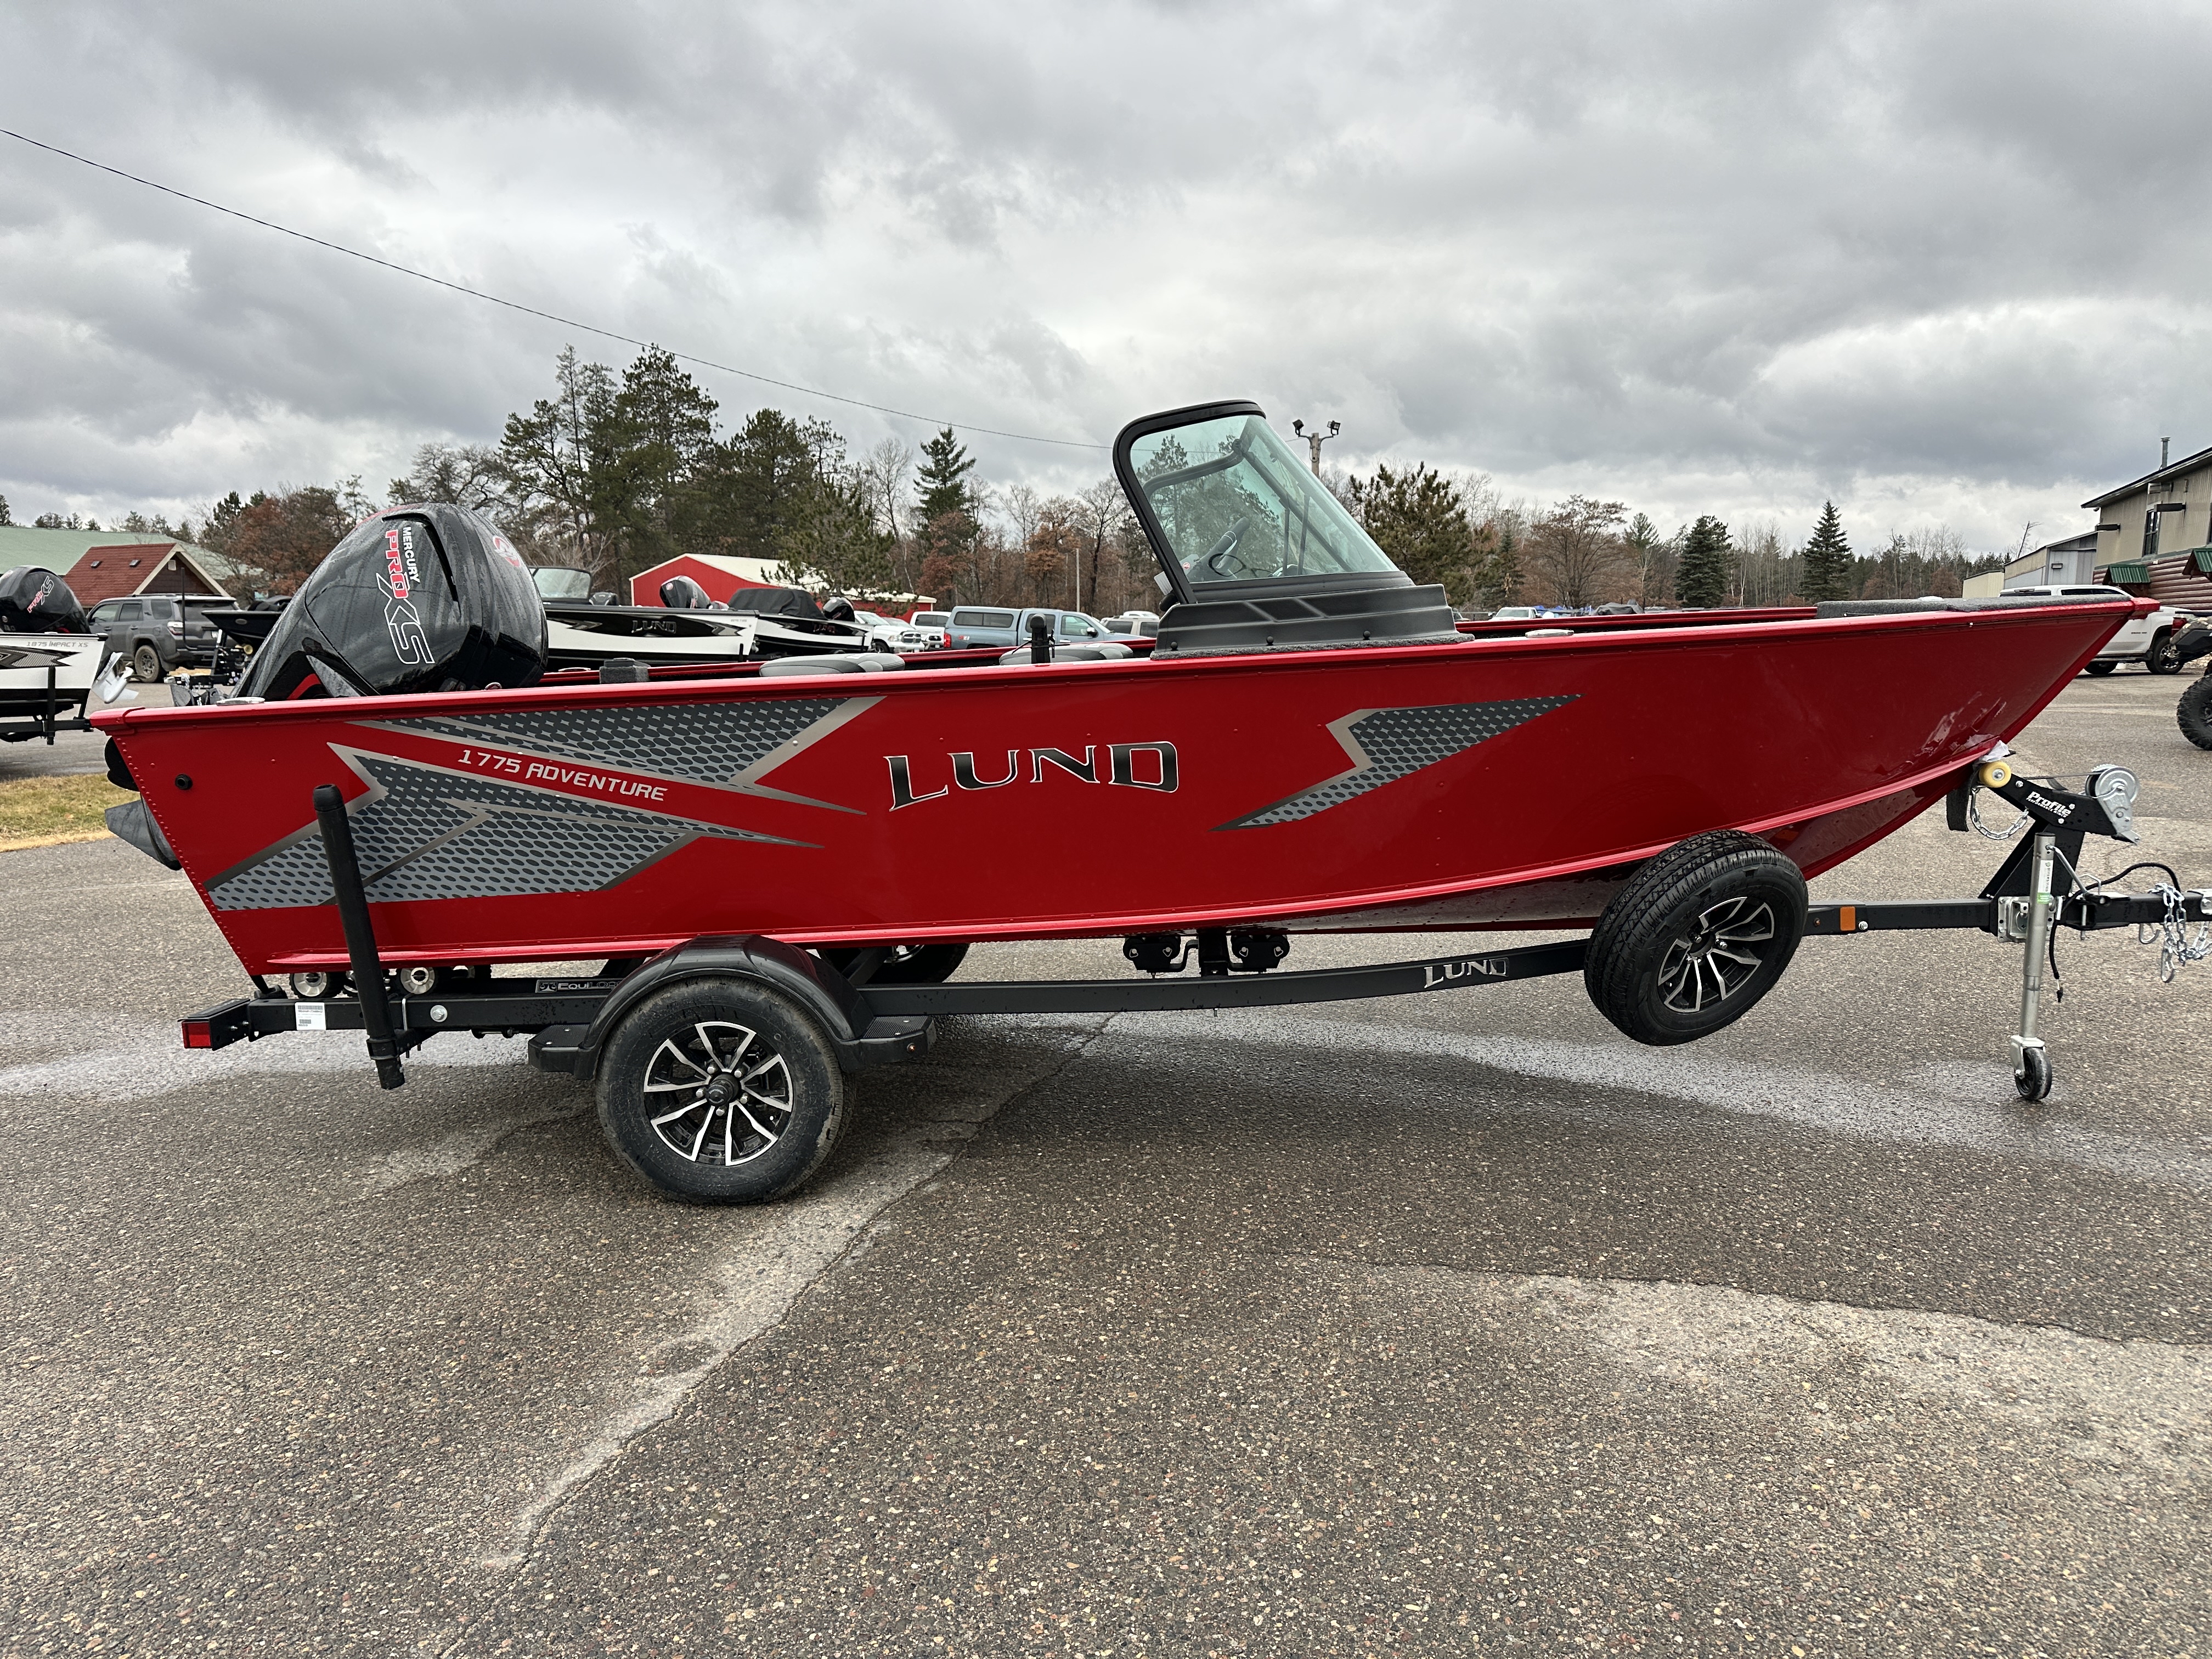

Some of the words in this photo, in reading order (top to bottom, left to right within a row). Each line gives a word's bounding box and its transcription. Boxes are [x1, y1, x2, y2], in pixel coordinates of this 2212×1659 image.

[385, 529, 409, 599] PRO
[403, 526, 420, 583] MERCURY
[375, 572, 435, 665] XS
[631, 620, 677, 634] LUND
[458, 749, 522, 774] 1775
[525, 762, 669, 802] ADVENTURE
[883, 740, 1180, 811] LUND
[2028, 791, 2072, 815] Profile
[1424, 957, 1510, 989] LUND
